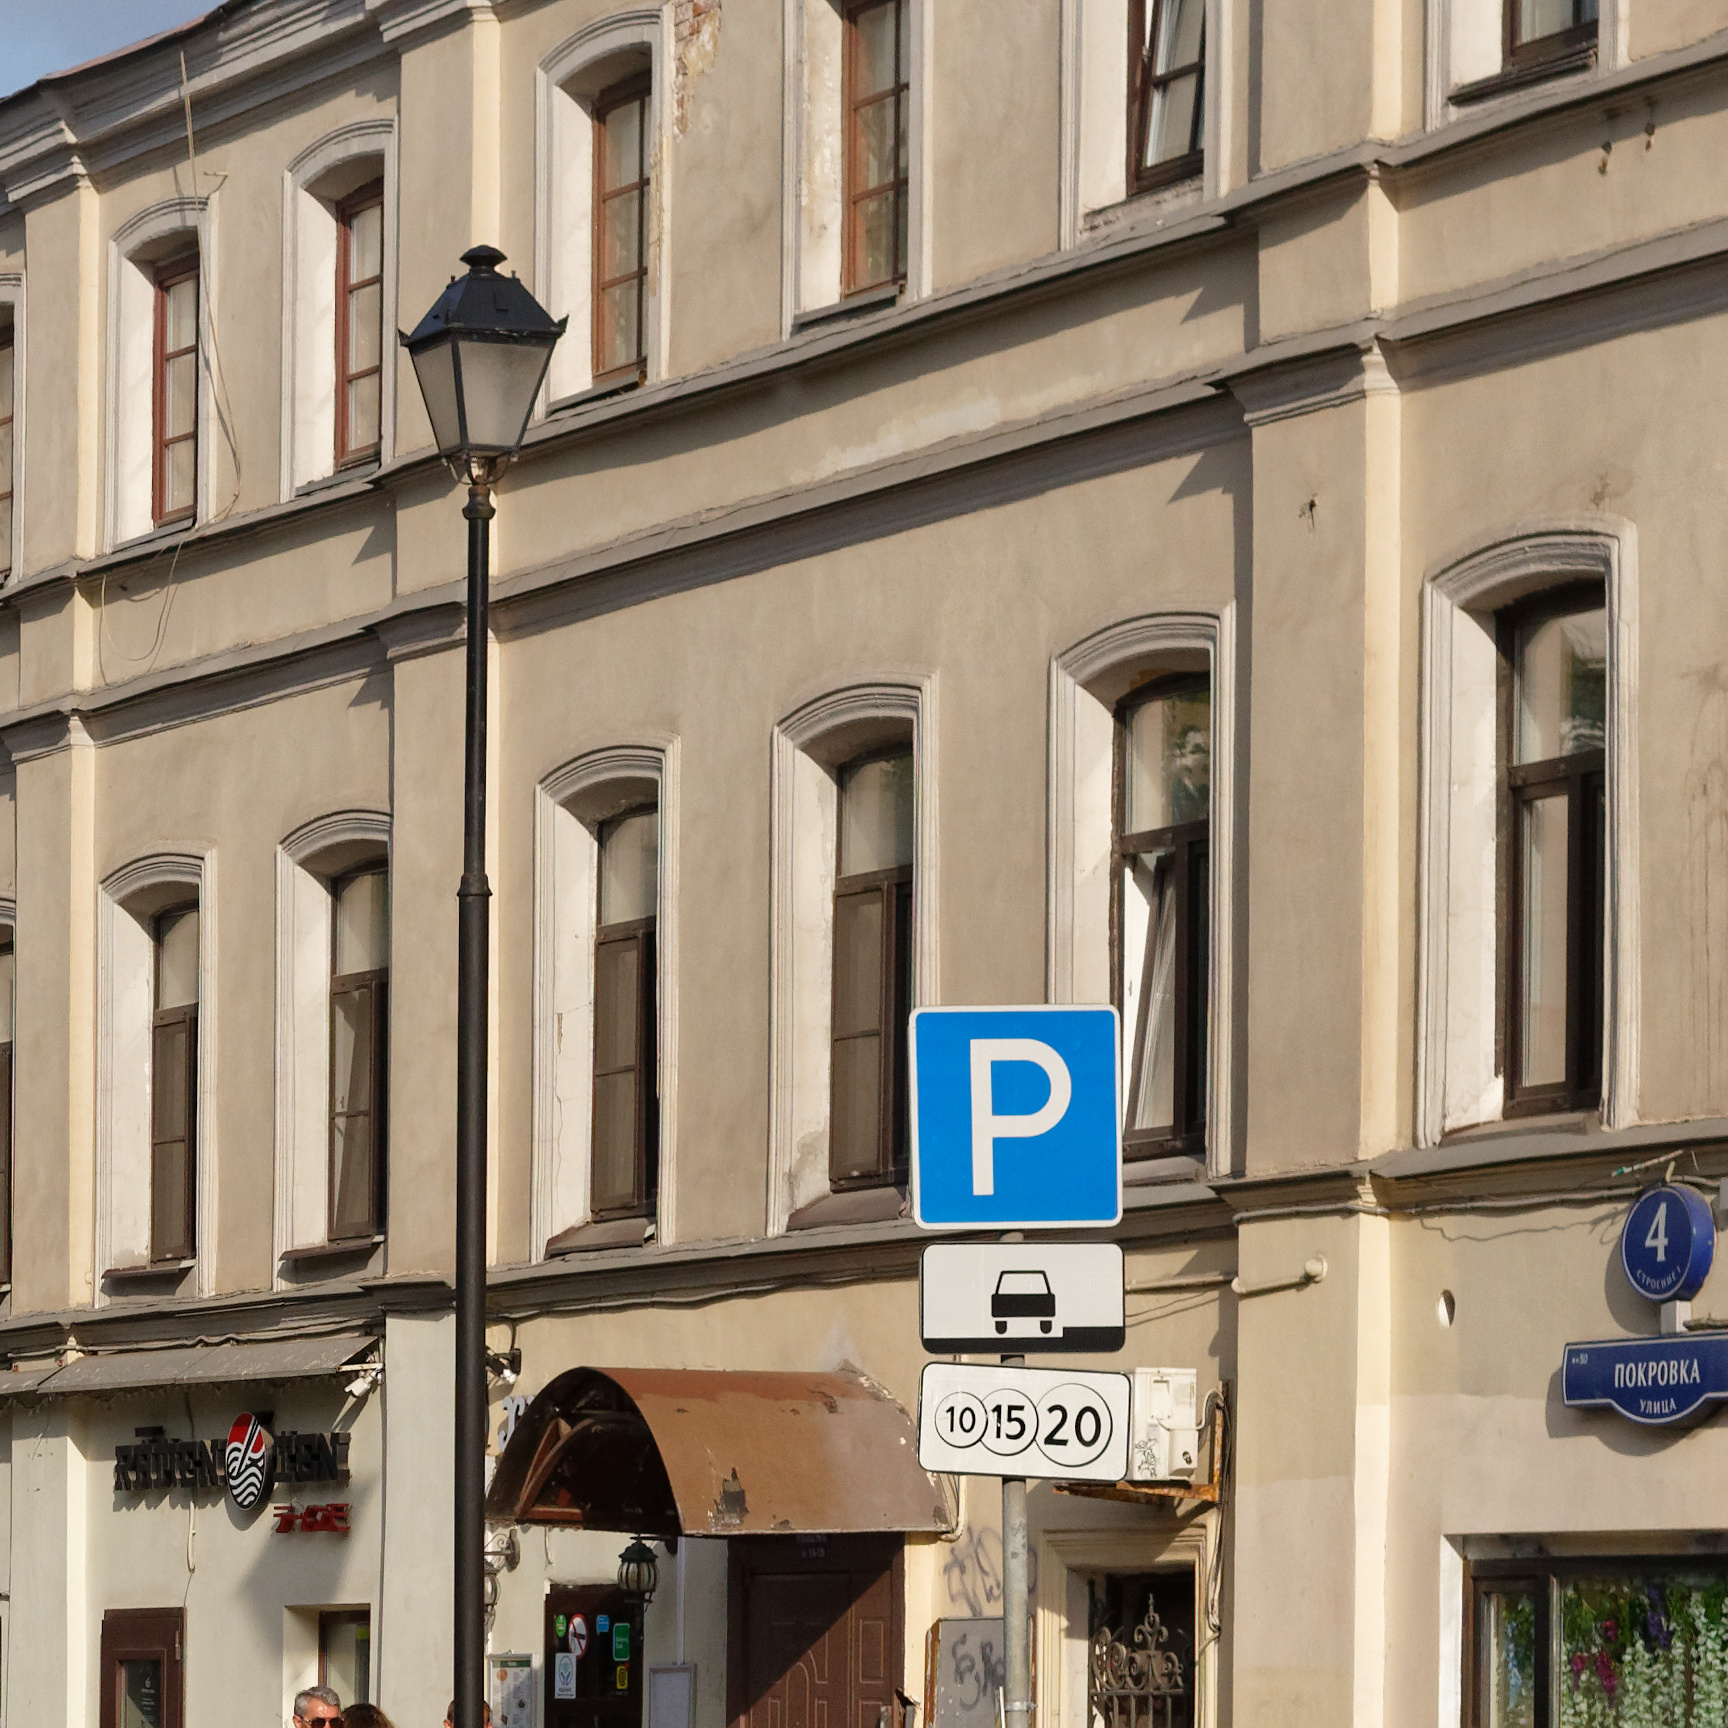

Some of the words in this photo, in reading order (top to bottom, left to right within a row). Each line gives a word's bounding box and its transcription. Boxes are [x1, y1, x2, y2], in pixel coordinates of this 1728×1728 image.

[970, 1038, 1072, 1196] P
[1645, 1202, 1669, 1263] 4
[1614, 1358, 1701, 1388] ПОКРОВКА
[945, 1404, 977, 1434] 10
[991, 1404, 1027, 1442] 15
[1044, 1403, 1102, 1448] 20
[1639, 1397, 1677, 1414] УЛИЦА
